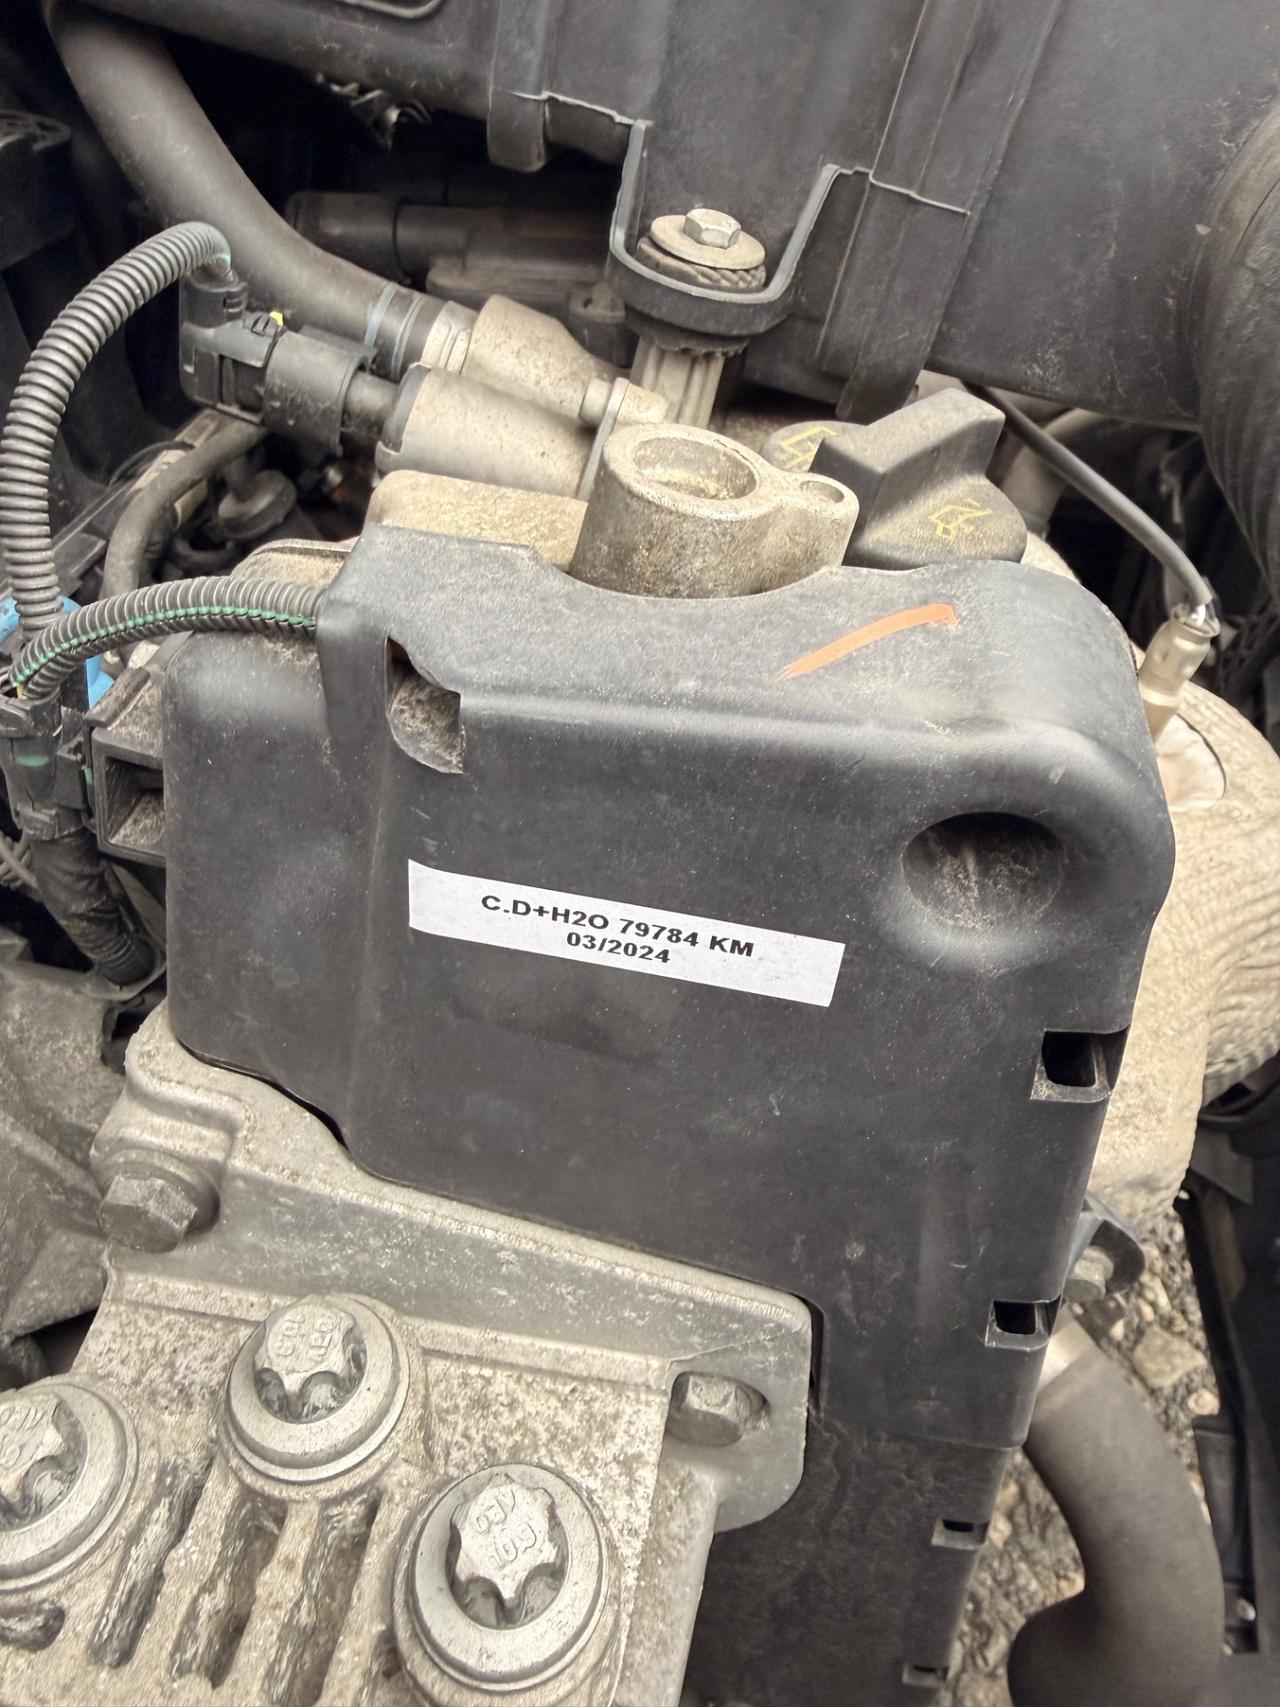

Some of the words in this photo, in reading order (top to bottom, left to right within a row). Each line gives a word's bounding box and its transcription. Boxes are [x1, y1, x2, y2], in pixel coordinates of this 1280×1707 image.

[481, 895, 609, 930] C.D+H2O
[619, 918, 699, 947] 79784
[709, 935, 754, 957] KM
[566, 932, 671, 964] 03/2024
